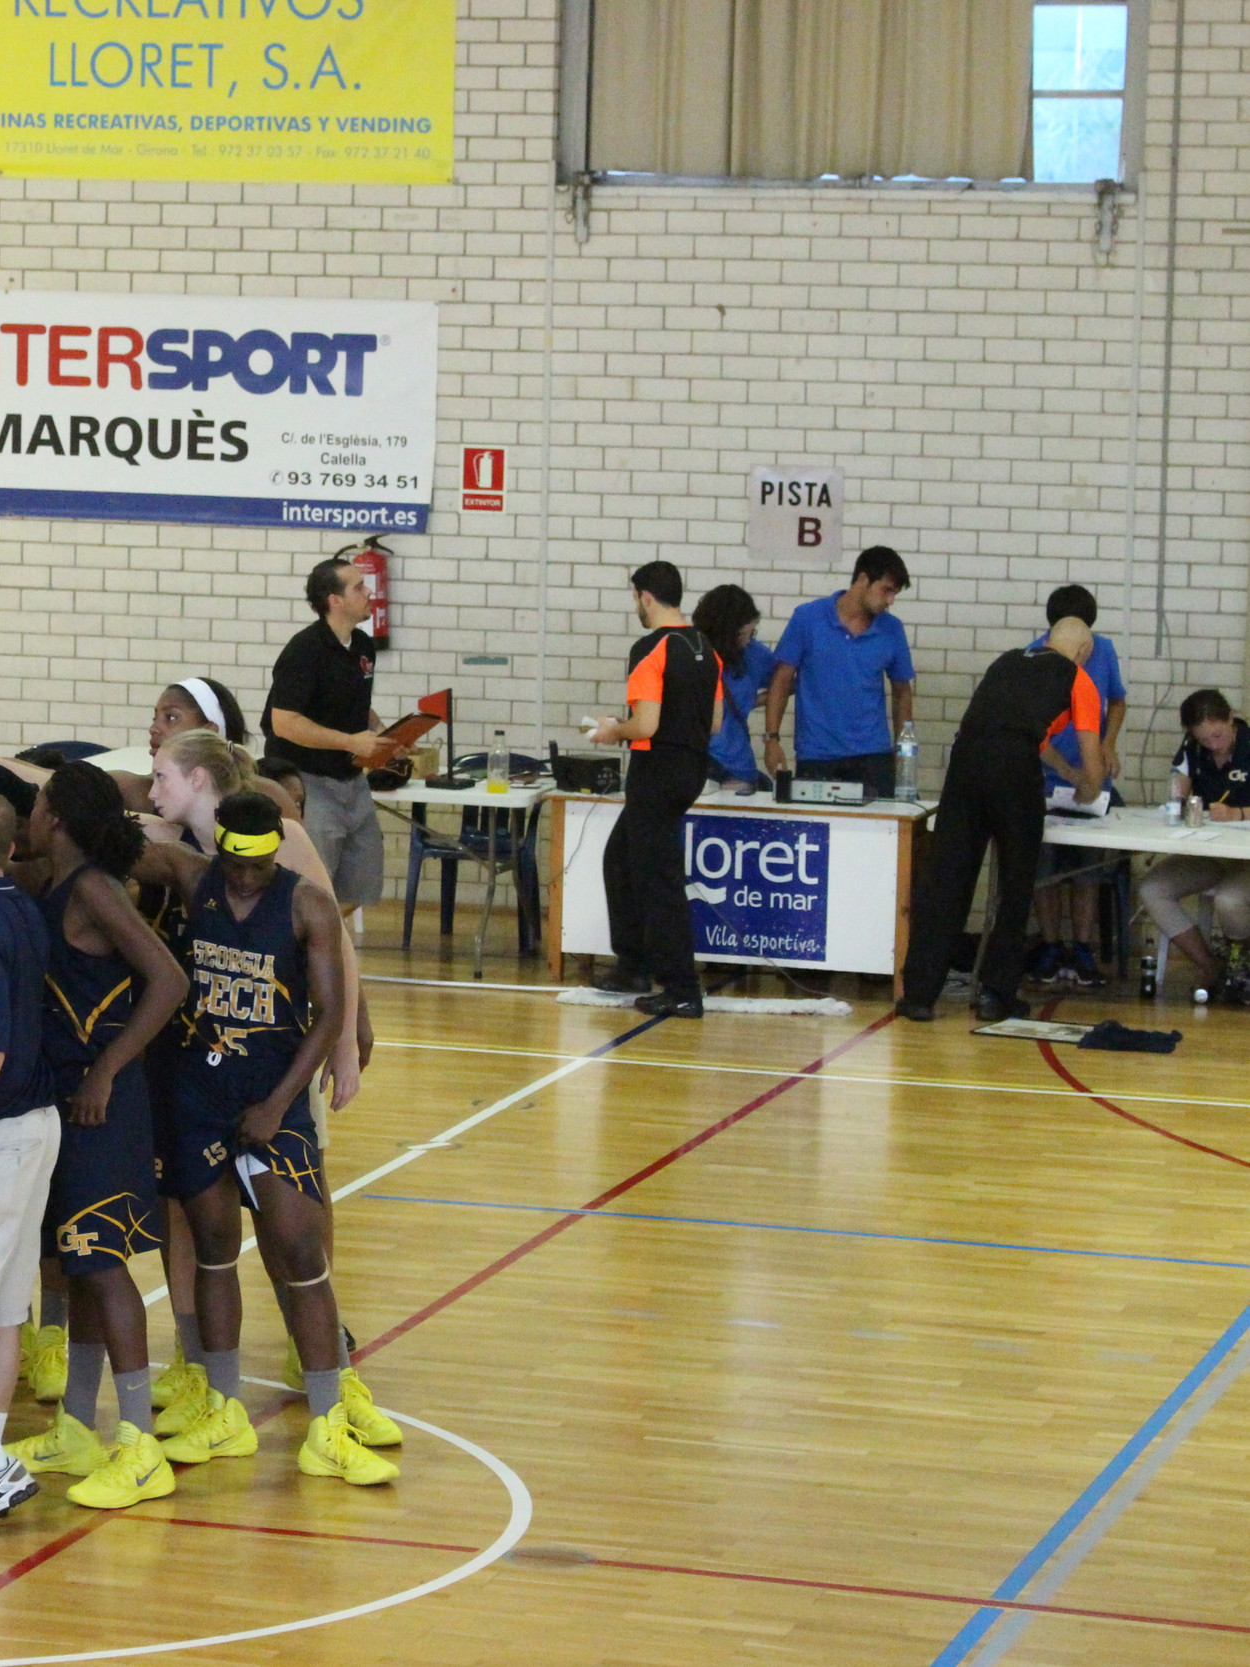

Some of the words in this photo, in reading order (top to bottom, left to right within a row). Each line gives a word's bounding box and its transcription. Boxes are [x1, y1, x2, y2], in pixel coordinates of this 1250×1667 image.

[49, 41, 238, 98] LLORET,
[262, 42, 362, 90] S.A.
[53, 113, 183, 132] RECREATIVAS,
[190, 115, 312, 132] DEPORTIVAS
[318, 116, 330, 132] Y
[336, 117, 432, 134] VENDING
[301, 433, 316, 445] de
[386, 436, 408, 448] 179
[320, 452, 367, 467] Calella
[287, 471, 313, 486] 93
[321, 472, 357, 488] 769
[364, 474, 389, 489] 34
[396, 475, 419, 490] 51
[464, 497, 502, 507] EXTINTOR
[760, 480, 832, 508] PISTA
[282, 501, 418, 528] intersport.es
[797, 516, 823, 548] B
[684, 821, 820, 886] loret
[733, 885, 763, 908] de
[769, 891, 818, 911] mar
[705, 924, 739, 948] Vila
[193, 939, 276, 979] GEORGIA
[202, 1140, 228, 1168] 15
